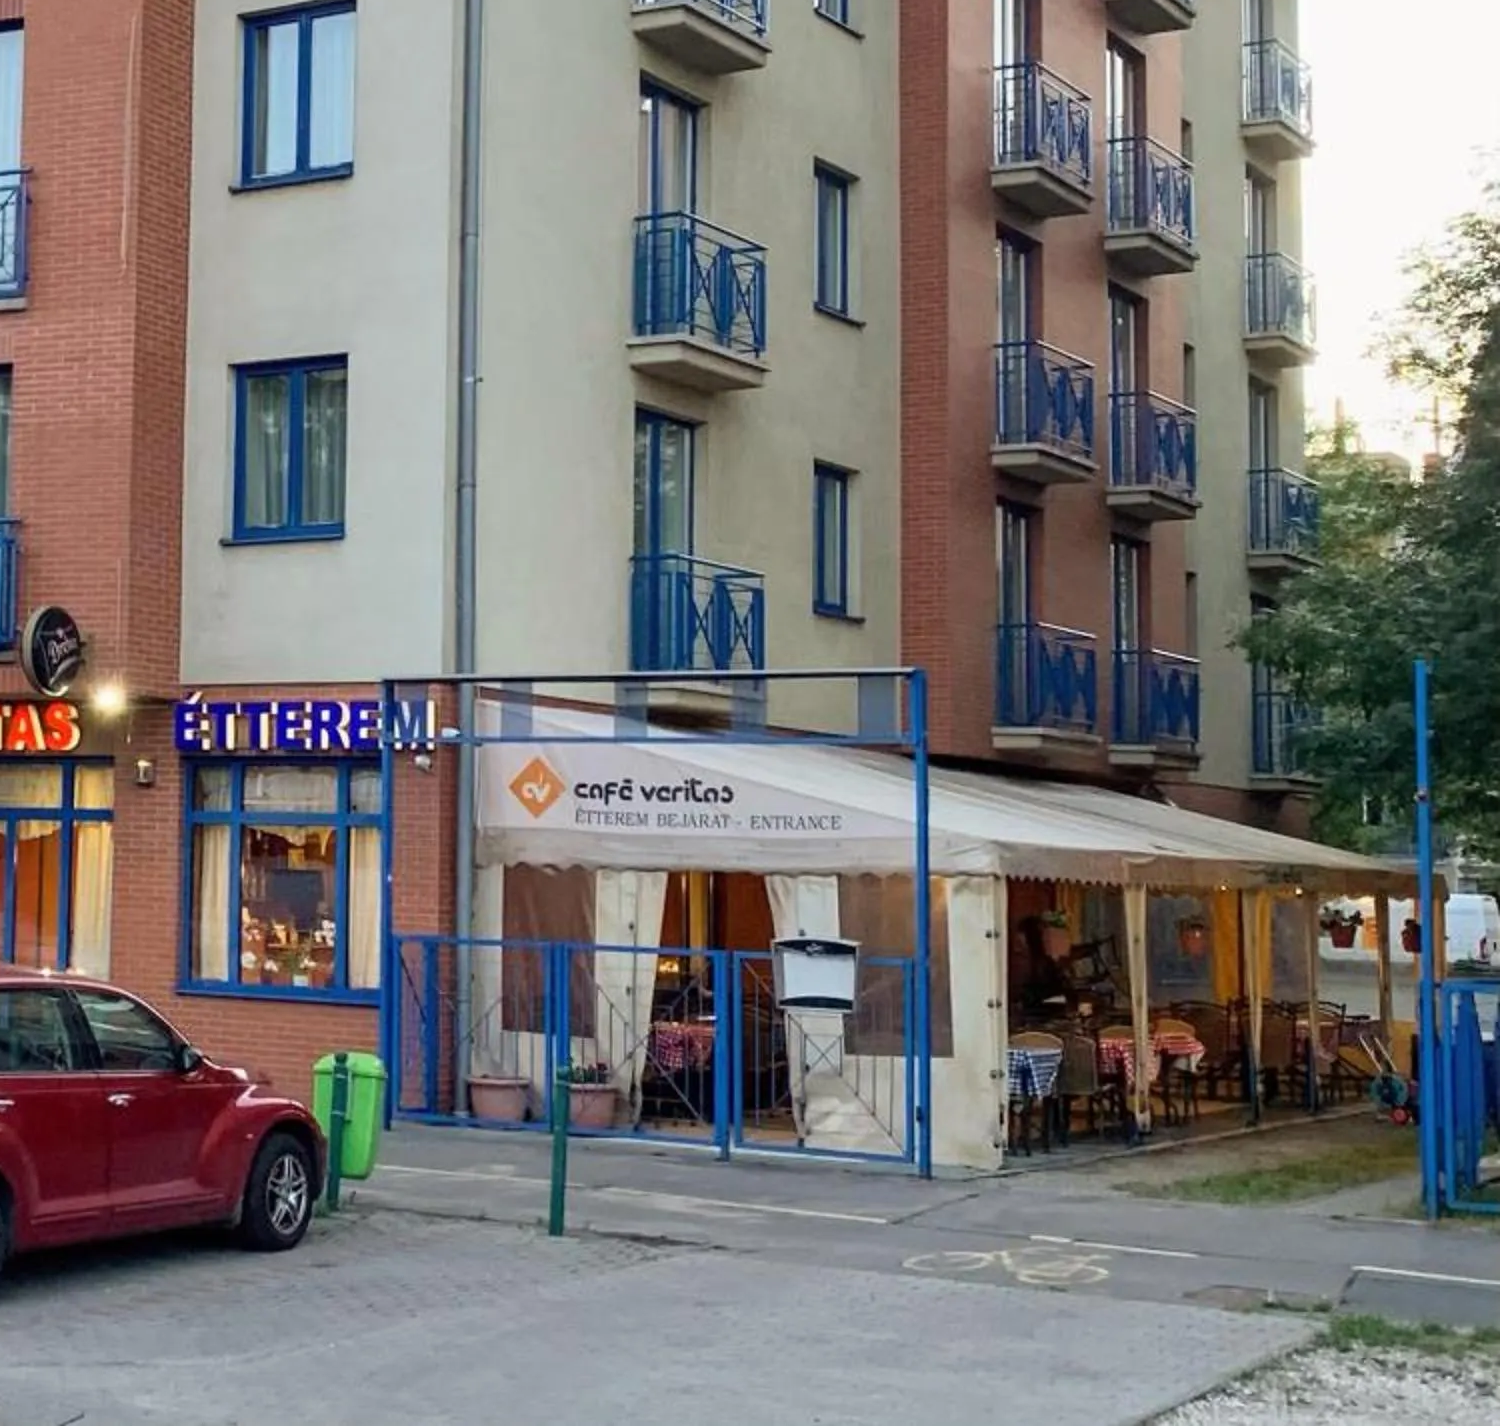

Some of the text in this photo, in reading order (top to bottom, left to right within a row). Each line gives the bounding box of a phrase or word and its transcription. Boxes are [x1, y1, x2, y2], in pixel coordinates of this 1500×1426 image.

[175, 690, 435, 751] ÉTTEREM
[639, 777, 735, 804] veritas
[574, 808, 649, 828] ÉTTEREM
[750, 815, 843, 832] ENTRANCE
